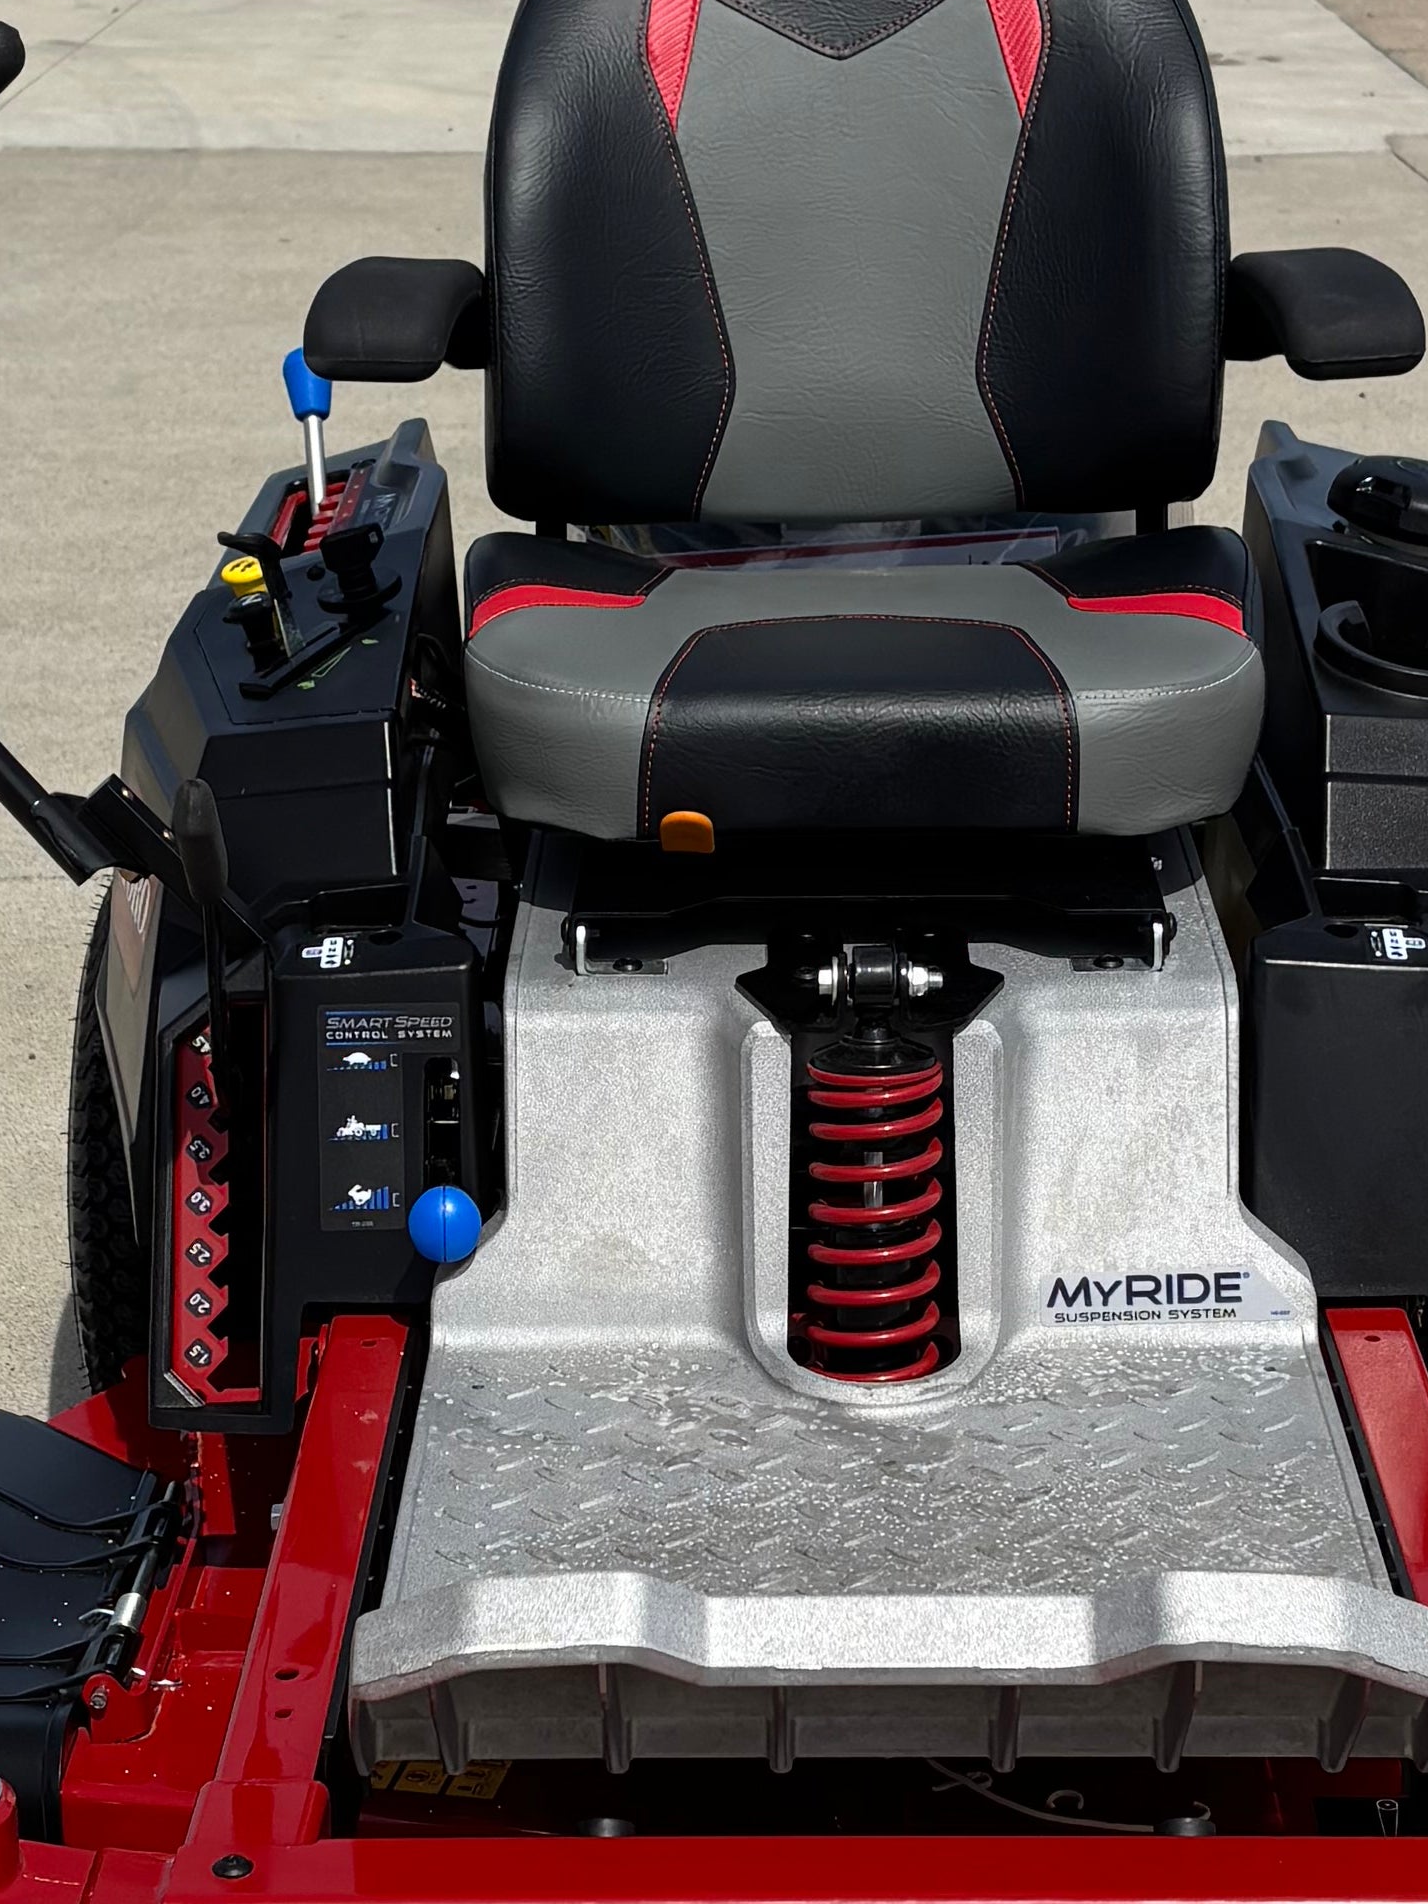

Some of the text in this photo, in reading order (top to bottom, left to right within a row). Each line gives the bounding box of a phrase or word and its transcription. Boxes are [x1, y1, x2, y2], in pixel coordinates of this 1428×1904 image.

[326, 1016, 452, 1029] SMART SPEED
[326, 1029, 452, 1040] CONTROL SYSTEM
[190, 1086, 210, 1105] 4.0
[189, 1140, 211, 1159] 3.5
[190, 1191, 211, 1212] 3.0
[1054, 1308, 1237, 1323] SUSPENSION SYSTEM
[189, 1345, 210, 1364] 1.5
